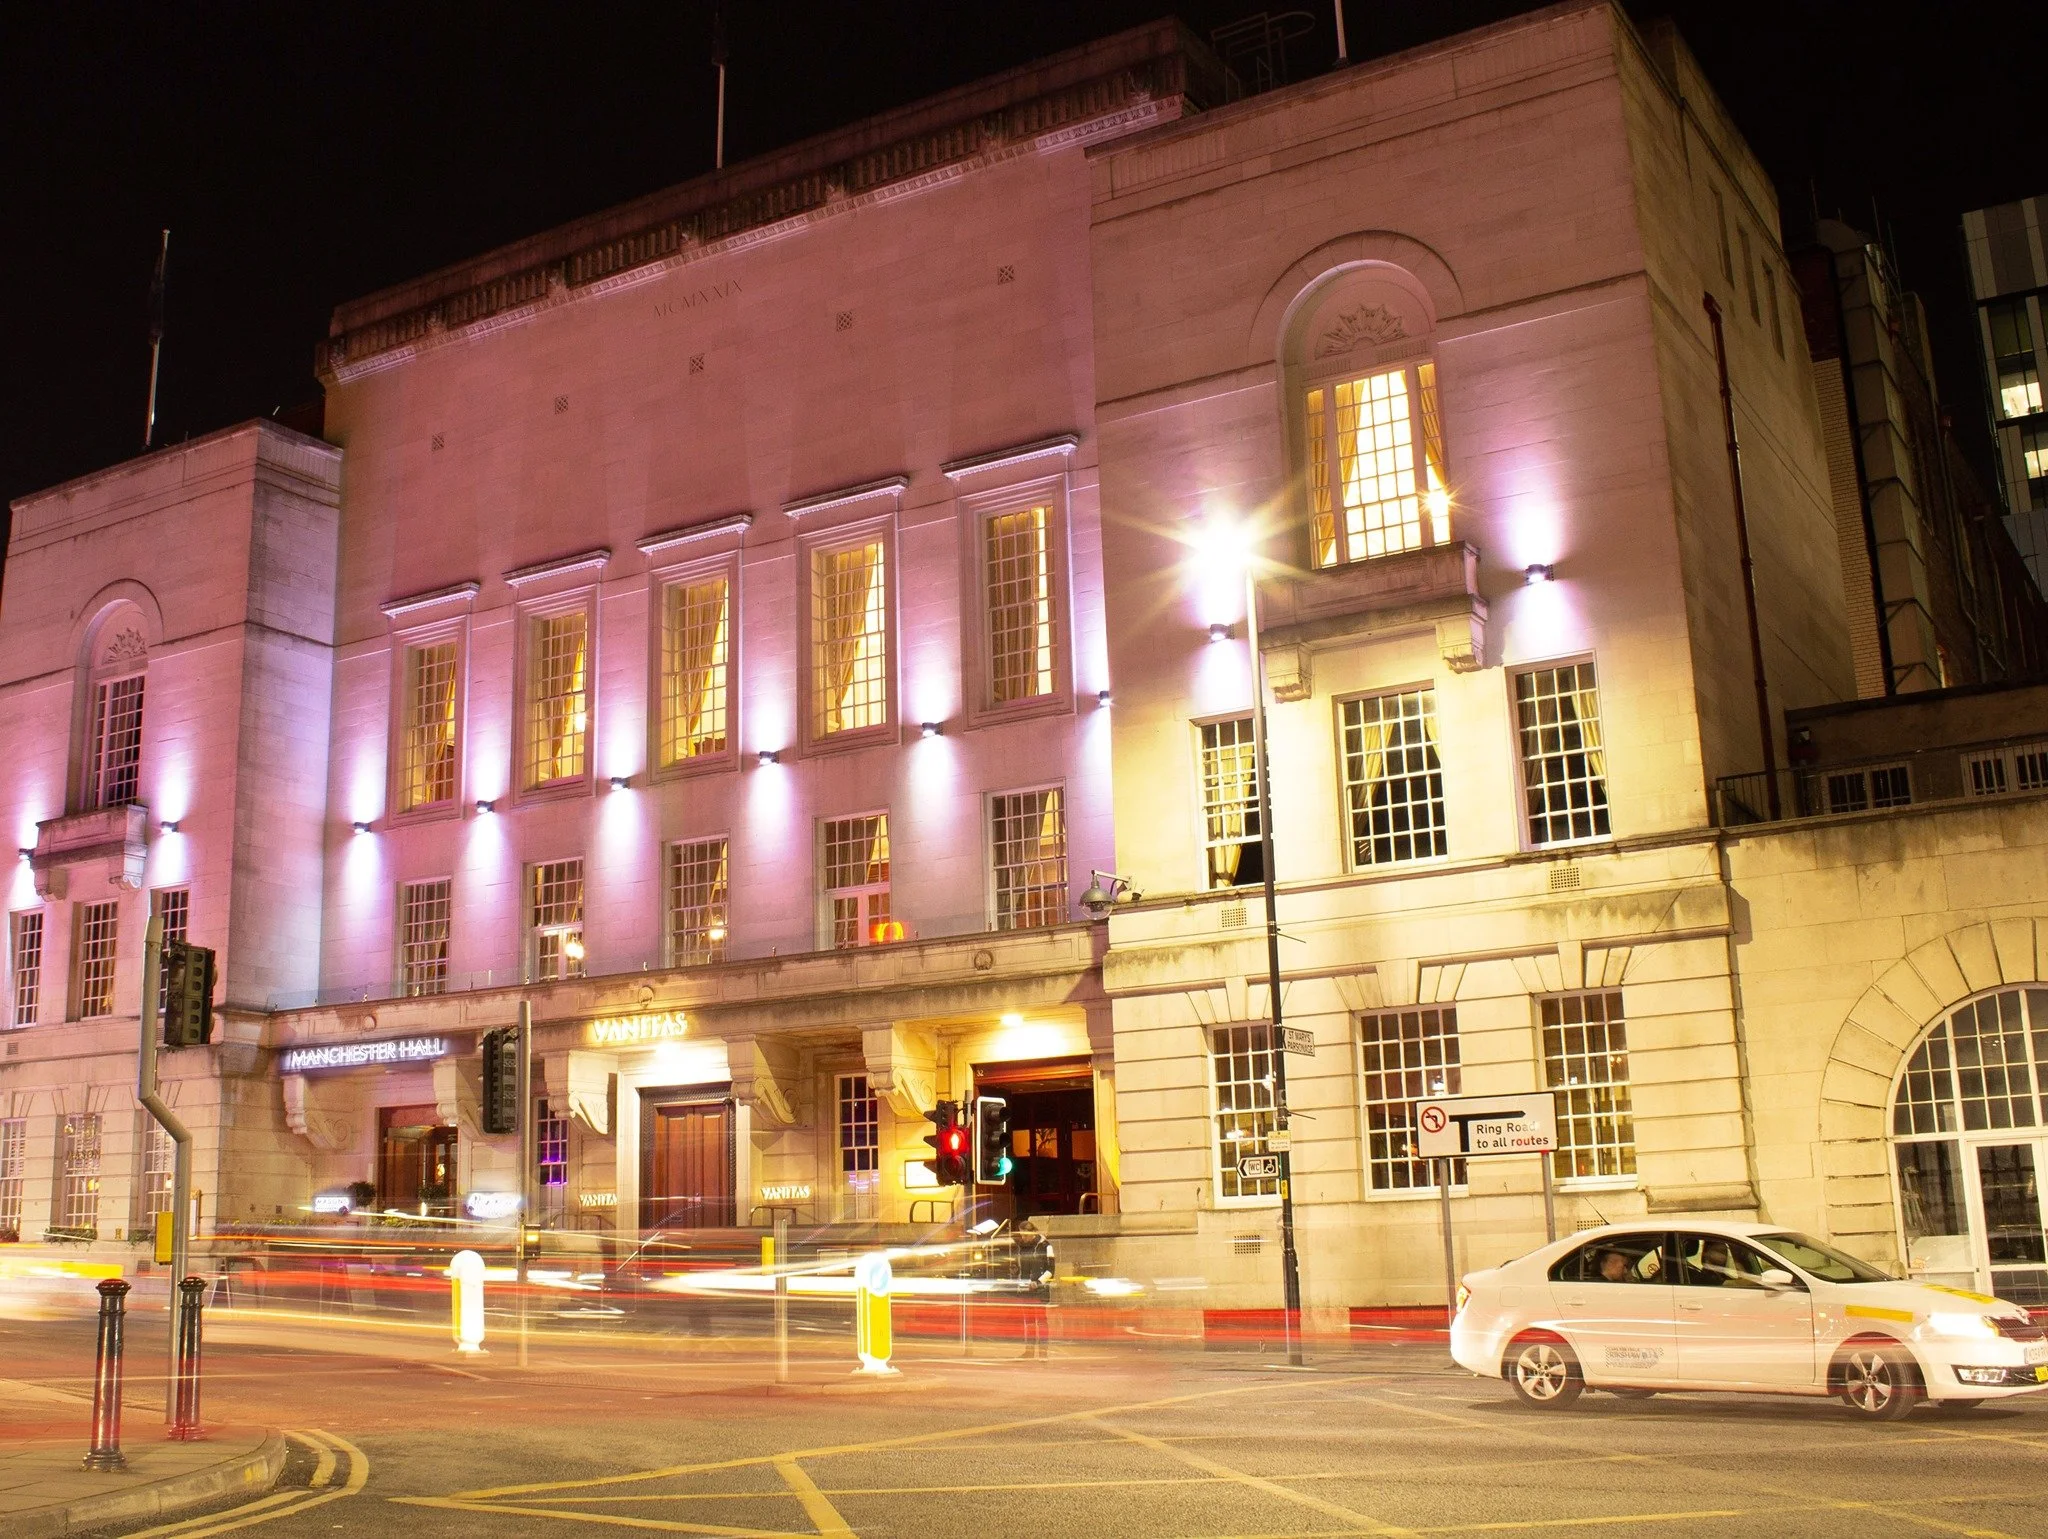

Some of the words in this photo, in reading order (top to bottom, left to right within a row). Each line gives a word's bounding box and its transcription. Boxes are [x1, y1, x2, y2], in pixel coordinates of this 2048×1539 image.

[592, 1012, 688, 1042] VANITAS
[291, 1043, 396, 1067] MANCHESTER
[400, 1038, 445, 1058] HALL
[1287, 1041, 1313, 1054] PARSONAGE
[1476, 1124, 1502, 1135] Ring
[1506, 1121, 1536, 1133] Road
[1477, 1138, 1489, 1149] to
[1492, 1137, 1507, 1148] all
[1511, 1135, 1549, 1147] routes
[1250, 1163, 1260, 1171] WC
[579, 1193, 617, 1206] VANITA
[761, 1185, 811, 1200] VANITAS
